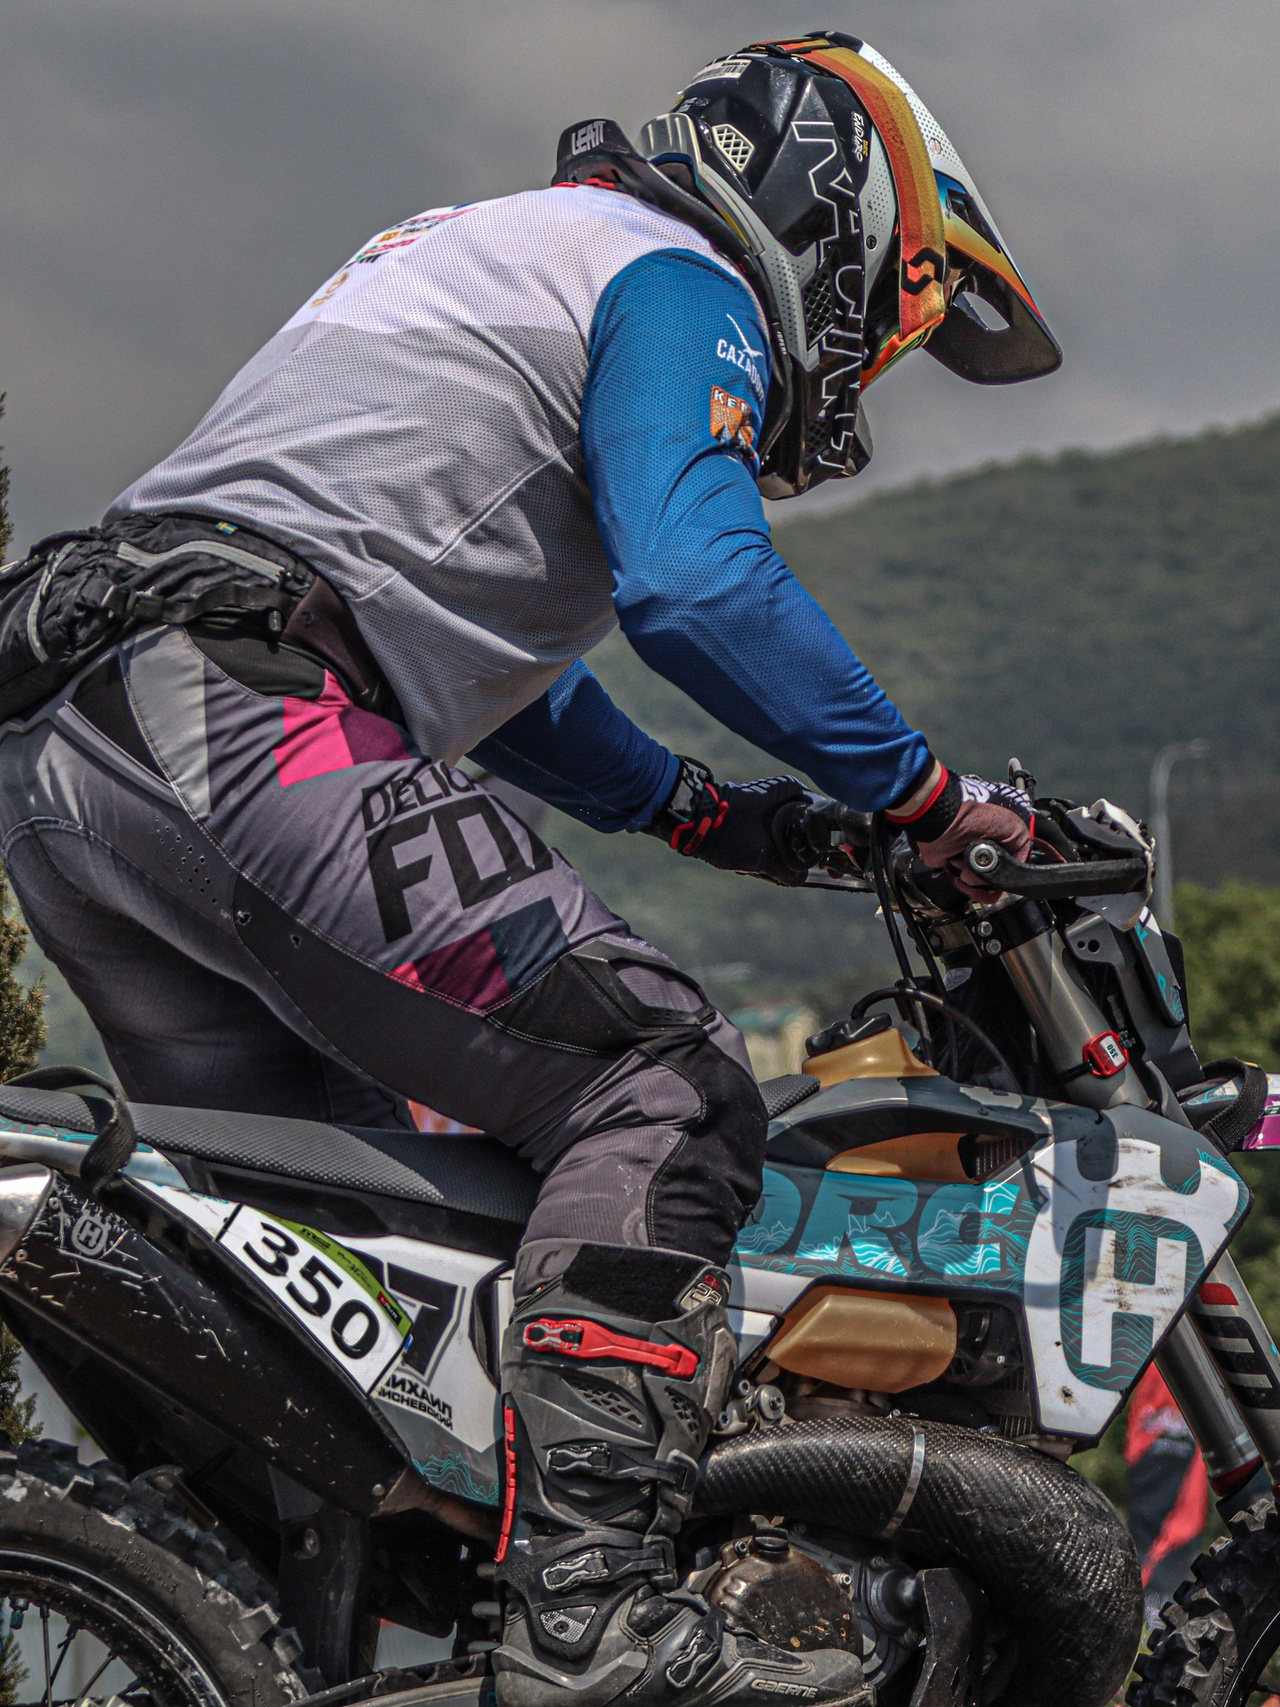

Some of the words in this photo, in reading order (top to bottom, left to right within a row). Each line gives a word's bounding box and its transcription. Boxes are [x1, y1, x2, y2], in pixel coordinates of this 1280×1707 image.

[571, 120, 606, 155] LEATT
[853, 112, 865, 163] ENDURO
[1106, 1044, 1119, 1060] 350
[240, 1222, 381, 1359] 350
[378, 1387, 454, 1431] ИСНЕВСКИЙ
[386, 1374, 453, 1420] ИХАИЛ
